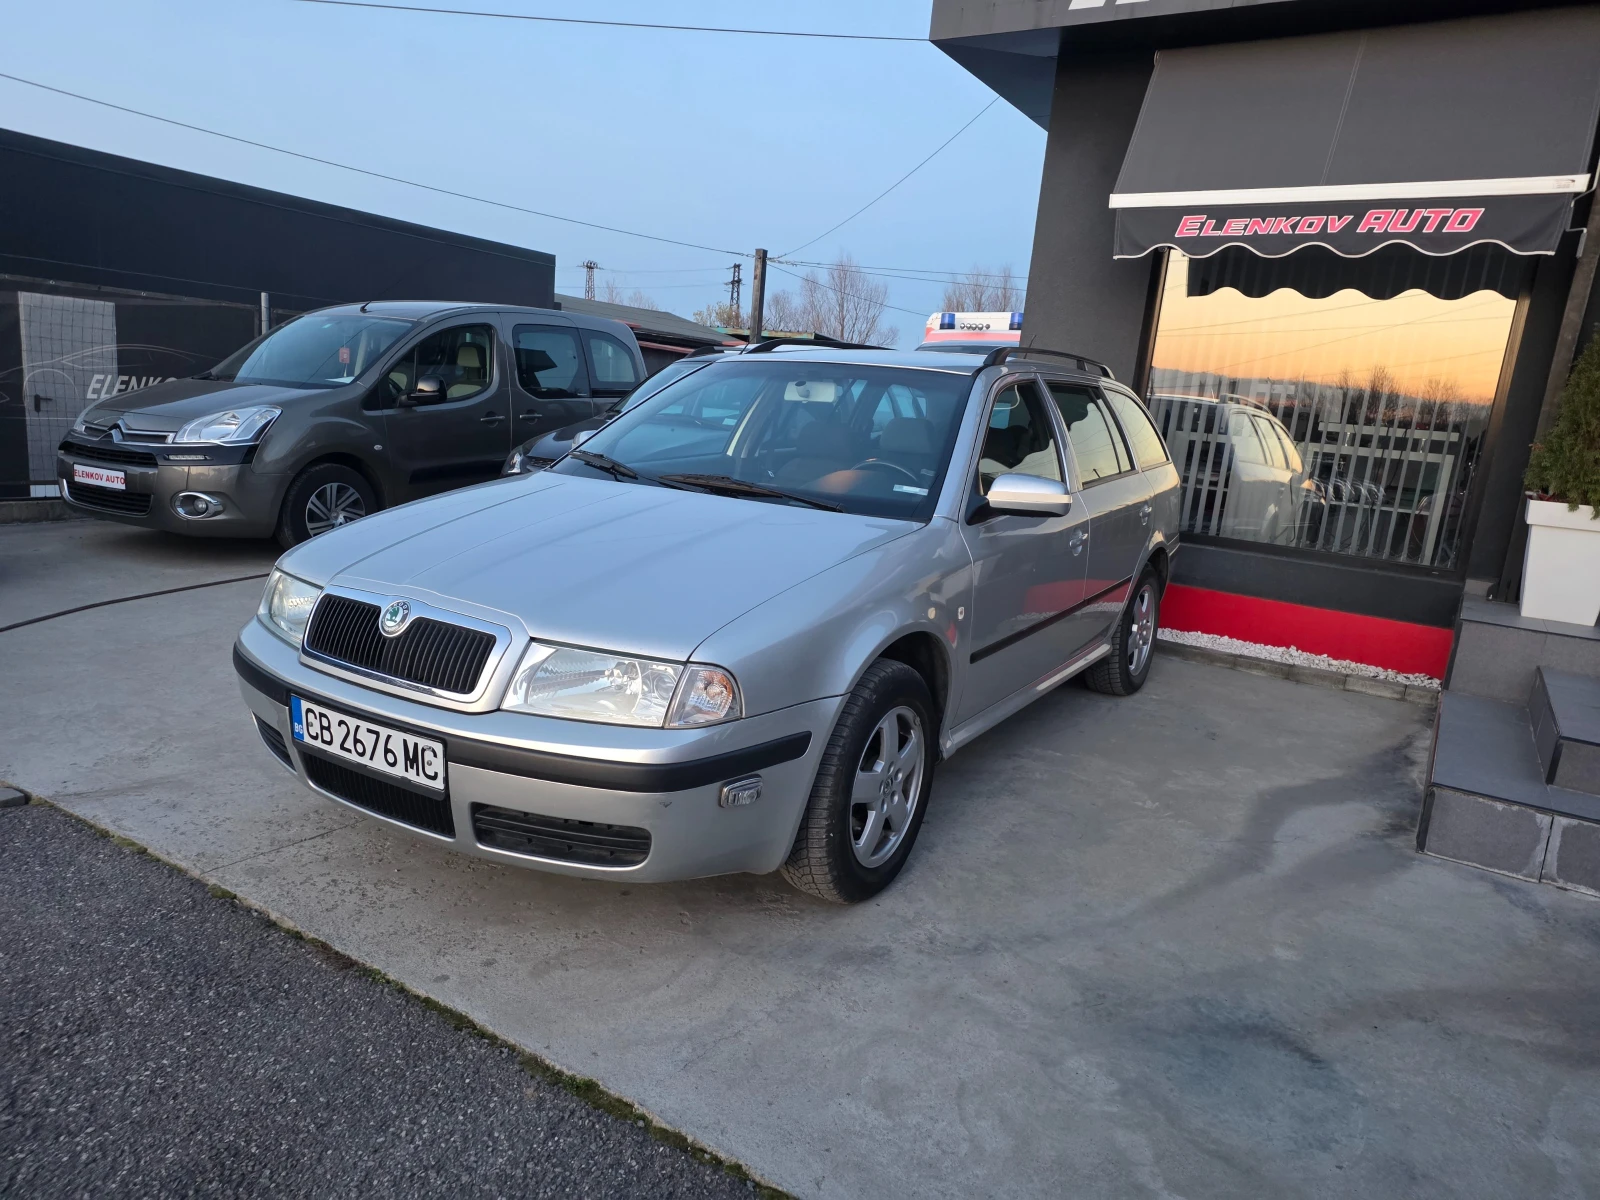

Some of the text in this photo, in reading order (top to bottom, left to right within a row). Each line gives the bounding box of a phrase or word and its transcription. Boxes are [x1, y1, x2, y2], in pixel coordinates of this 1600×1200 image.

[1175, 208, 1485, 237] ELENKOV AUTO
[74, 469, 127, 485] ELENKOV AUTO
[294, 722, 304, 734] BG
